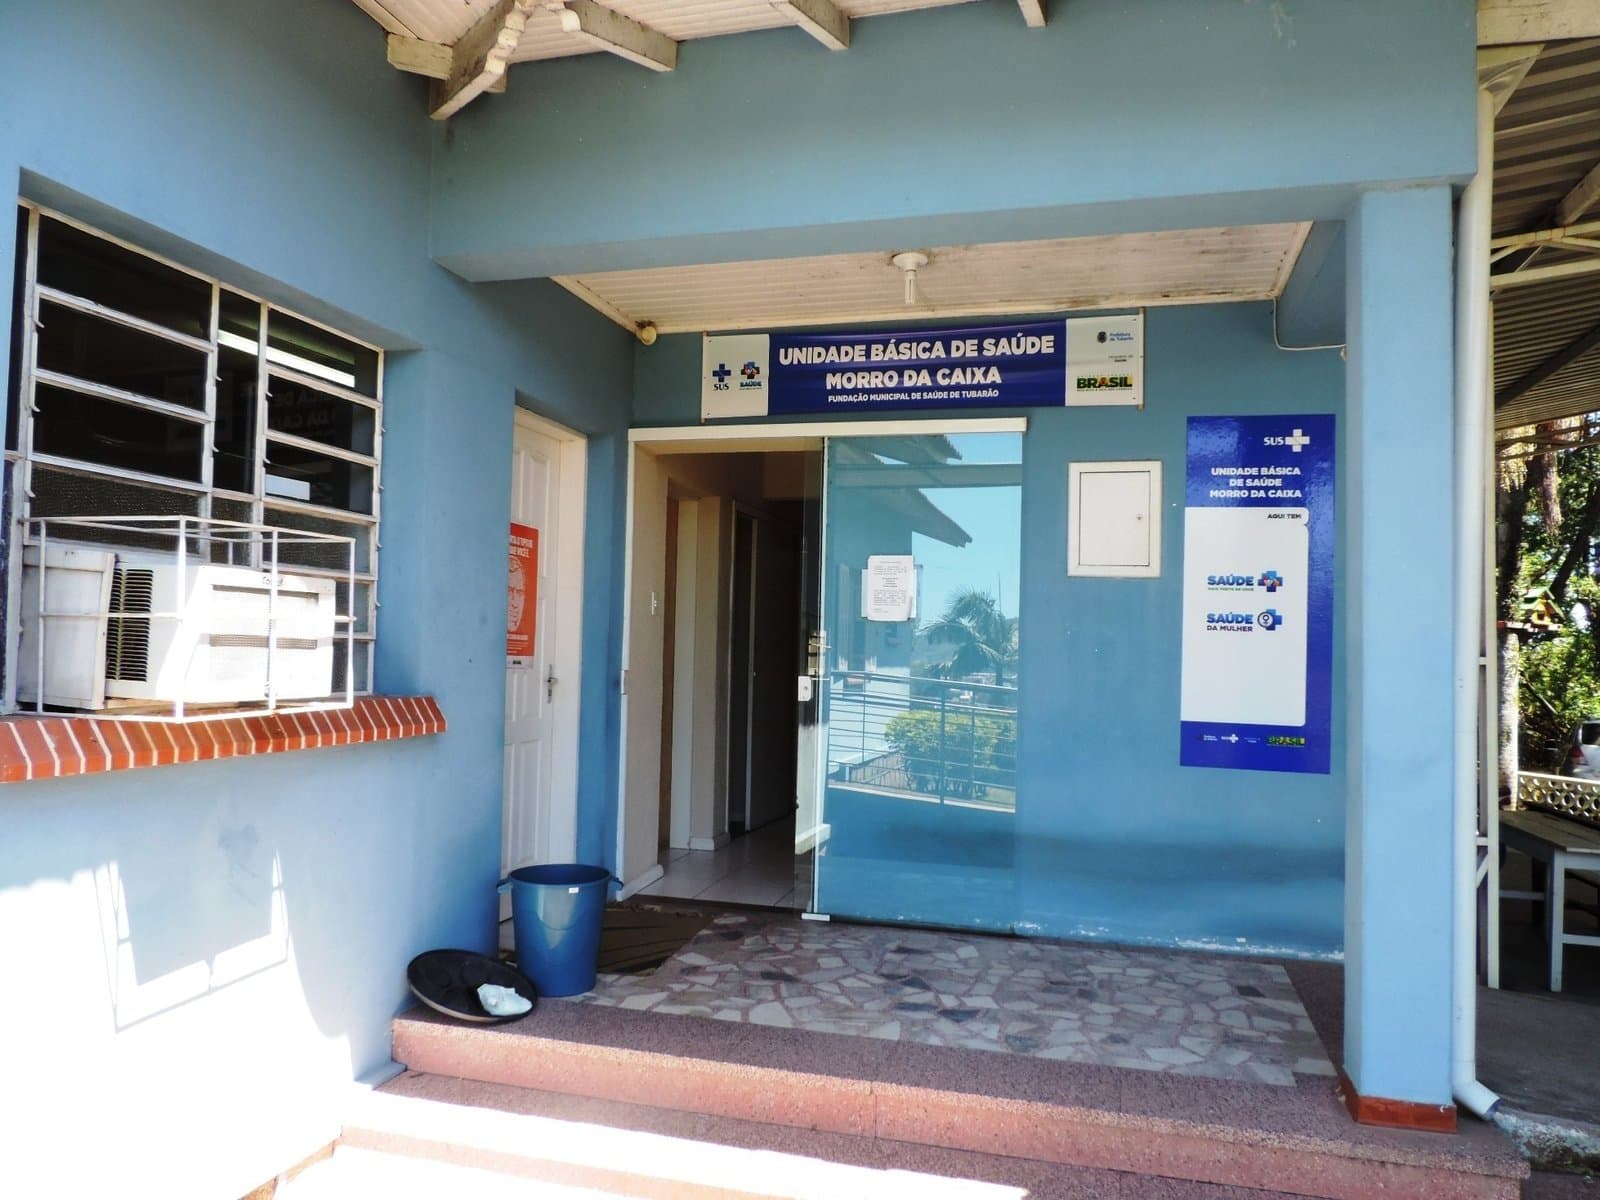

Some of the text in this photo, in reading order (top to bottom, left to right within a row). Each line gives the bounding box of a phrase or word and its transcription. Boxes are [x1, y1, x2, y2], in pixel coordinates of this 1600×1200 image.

[779, 333, 1055, 365] UNIDADE BÁSICA DE SAÚDE
[826, 366, 1002, 390] MORRO DA CAIXA
[1077, 376, 1133, 388] BRASIL
[713, 383, 729, 391] SUS
[828, 393, 868, 402] FUNDAÇÃO
[870, 392, 910, 401] MUNICIPAL
[911, 392, 922, 400] DE
[922, 390, 948, 399] SAÚDE
[962, 388, 999, 398] TUBARÃO
[1263, 437, 1284, 445] SUS
[1211, 466, 1301, 475] UNIDADE BÁSICA
[1229, 477, 1282, 487] DE SAÚDE
[1209, 489, 1302, 498] MORRO DA CAIXA
[1207, 574, 1254, 586] SAÚDE
[1206, 612, 1253, 624] SAÚDE
